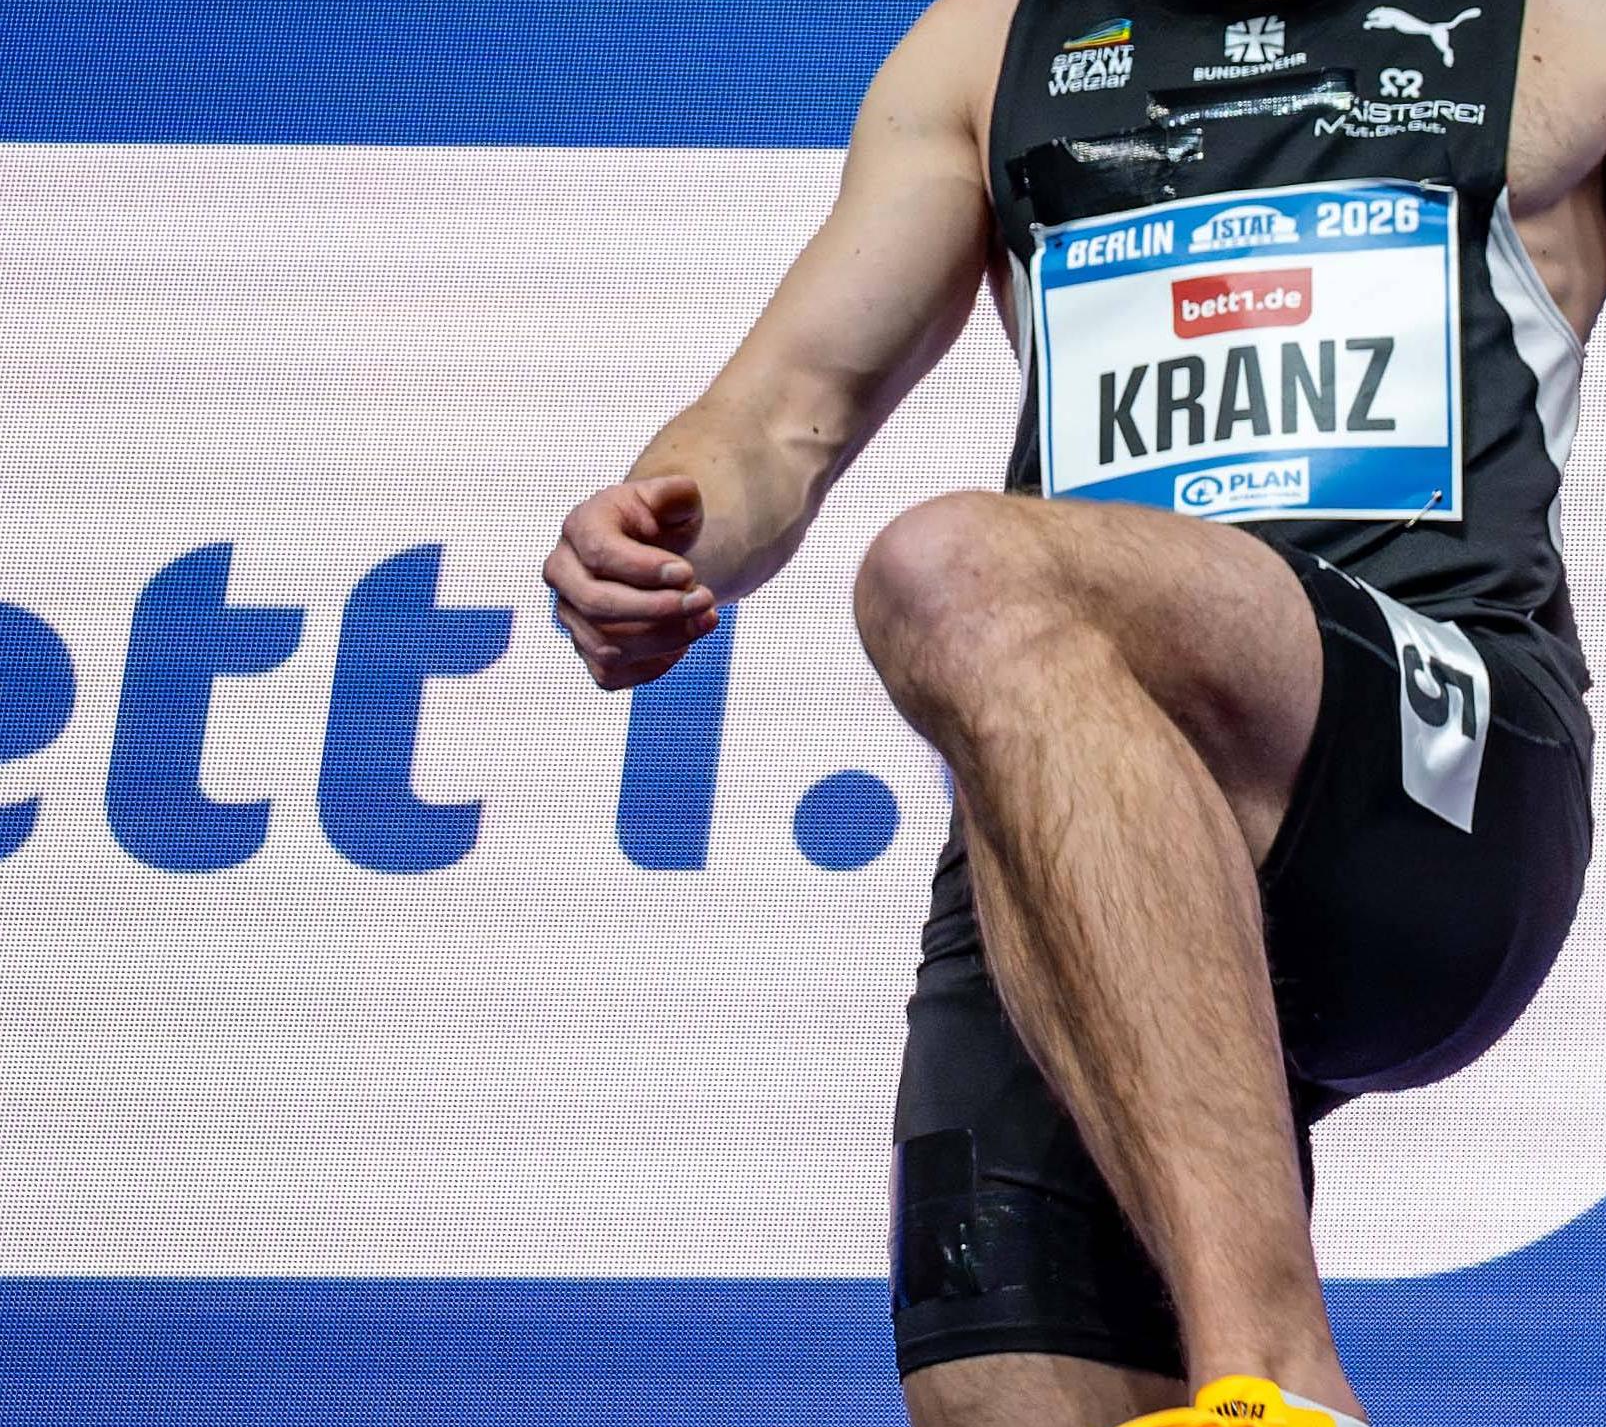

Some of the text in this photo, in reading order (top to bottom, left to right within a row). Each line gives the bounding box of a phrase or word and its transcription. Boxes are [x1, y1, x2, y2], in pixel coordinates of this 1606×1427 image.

[1050, 56, 1134, 79] TEAM
[1052, 44, 1135, 64] SPRINT
[1193, 52, 1308, 82] BUNDESWEHR
[1047, 73, 1131, 97] Wetzlar
[1066, 198, 1420, 270] BERLIN ISTAF 2026
[1181, 287, 1302, 323] bett1.de
[1098, 336, 1396, 466] KRANZ
[1230, 469, 1302, 492] PLAN
[1402, 643, 1477, 741] 5
